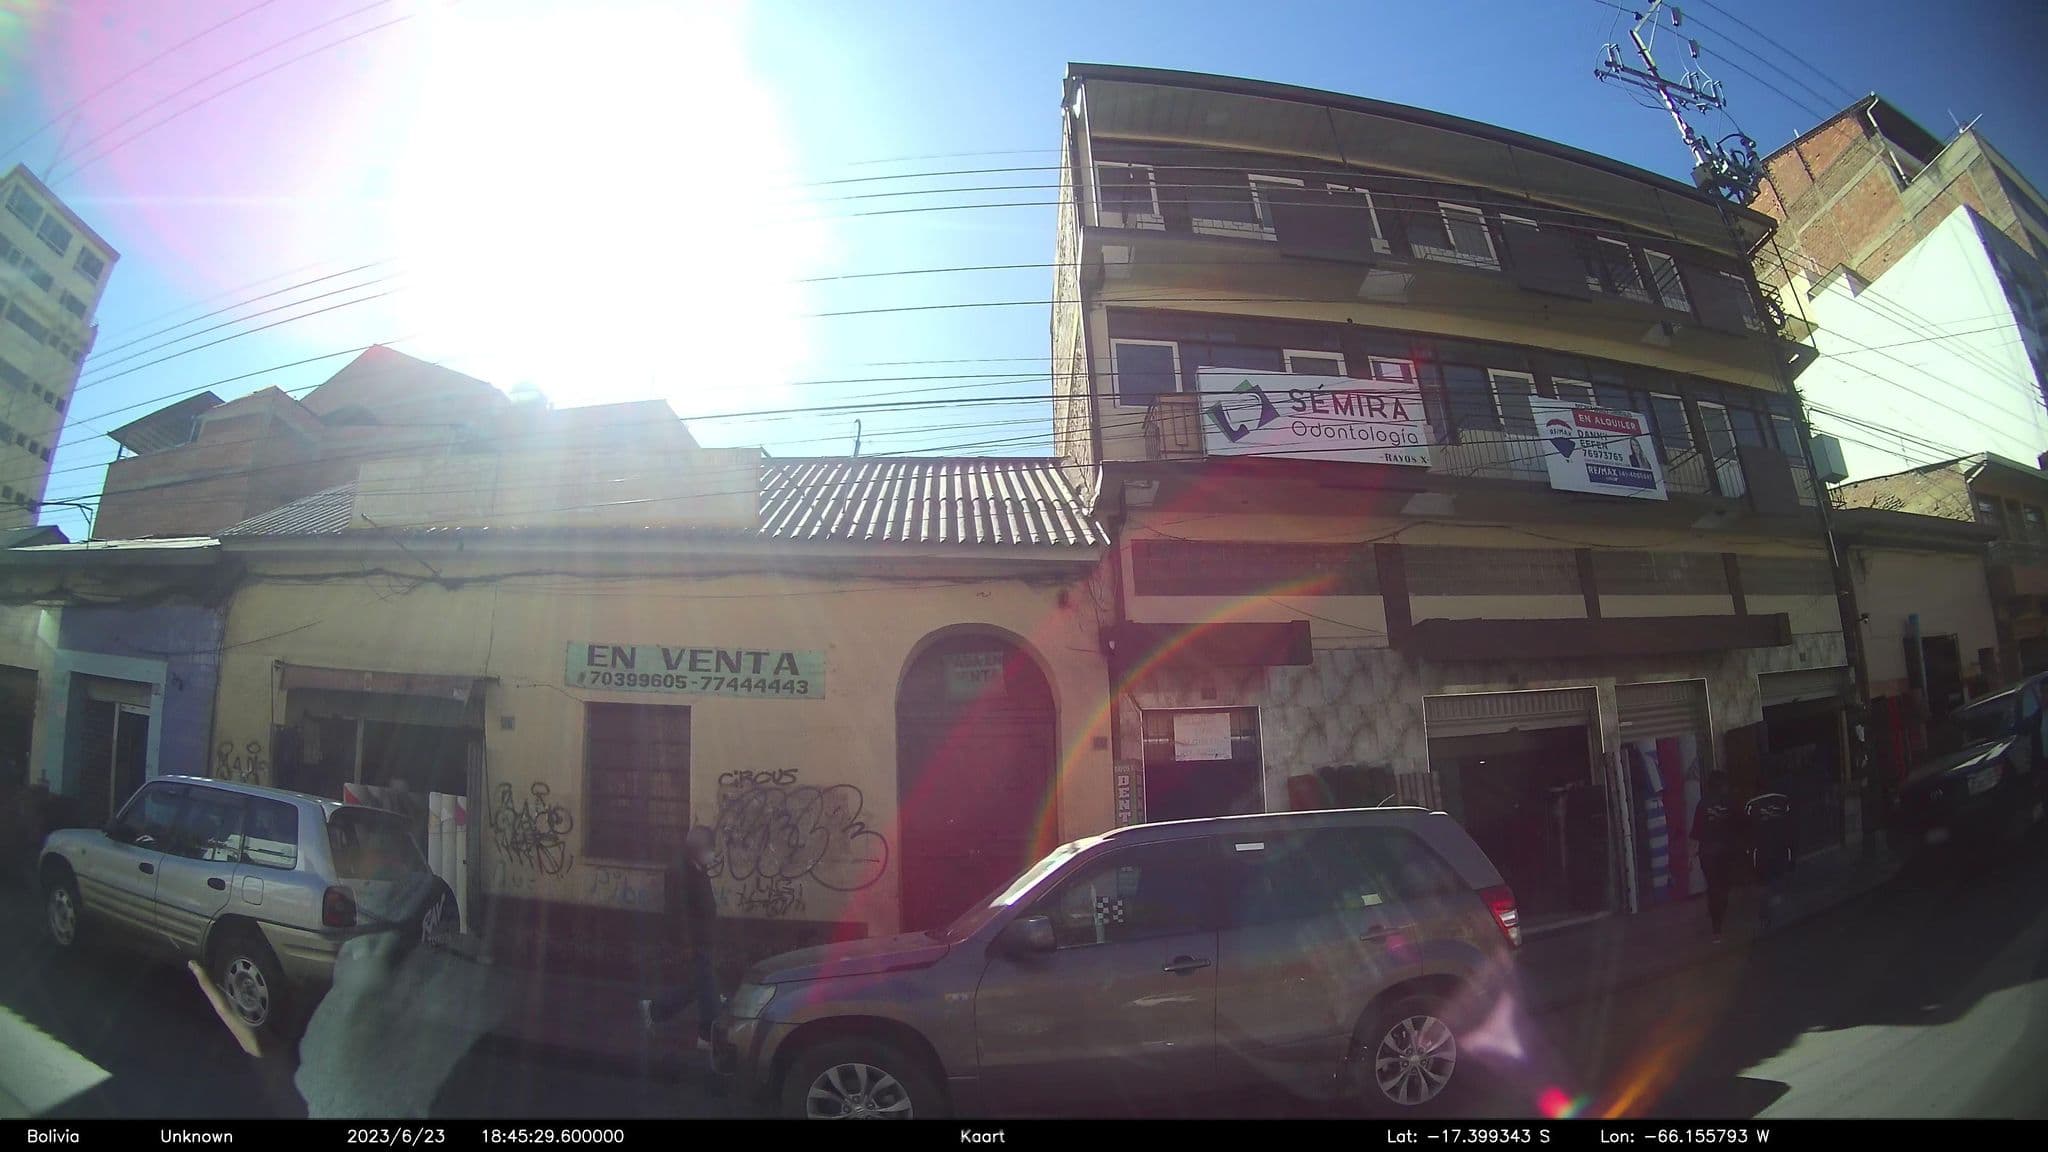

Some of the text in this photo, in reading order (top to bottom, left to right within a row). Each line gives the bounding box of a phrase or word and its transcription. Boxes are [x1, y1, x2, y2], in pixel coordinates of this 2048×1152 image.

[1288, 384, 1411, 421] SÉMIRA
[1291, 420, 1419, 448] Odontología
[1579, 414, 1636, 430] EN ALQUILER
[1582, 449, 1624, 462] 76973765
[587, 644, 800, 676] EN VENTA
